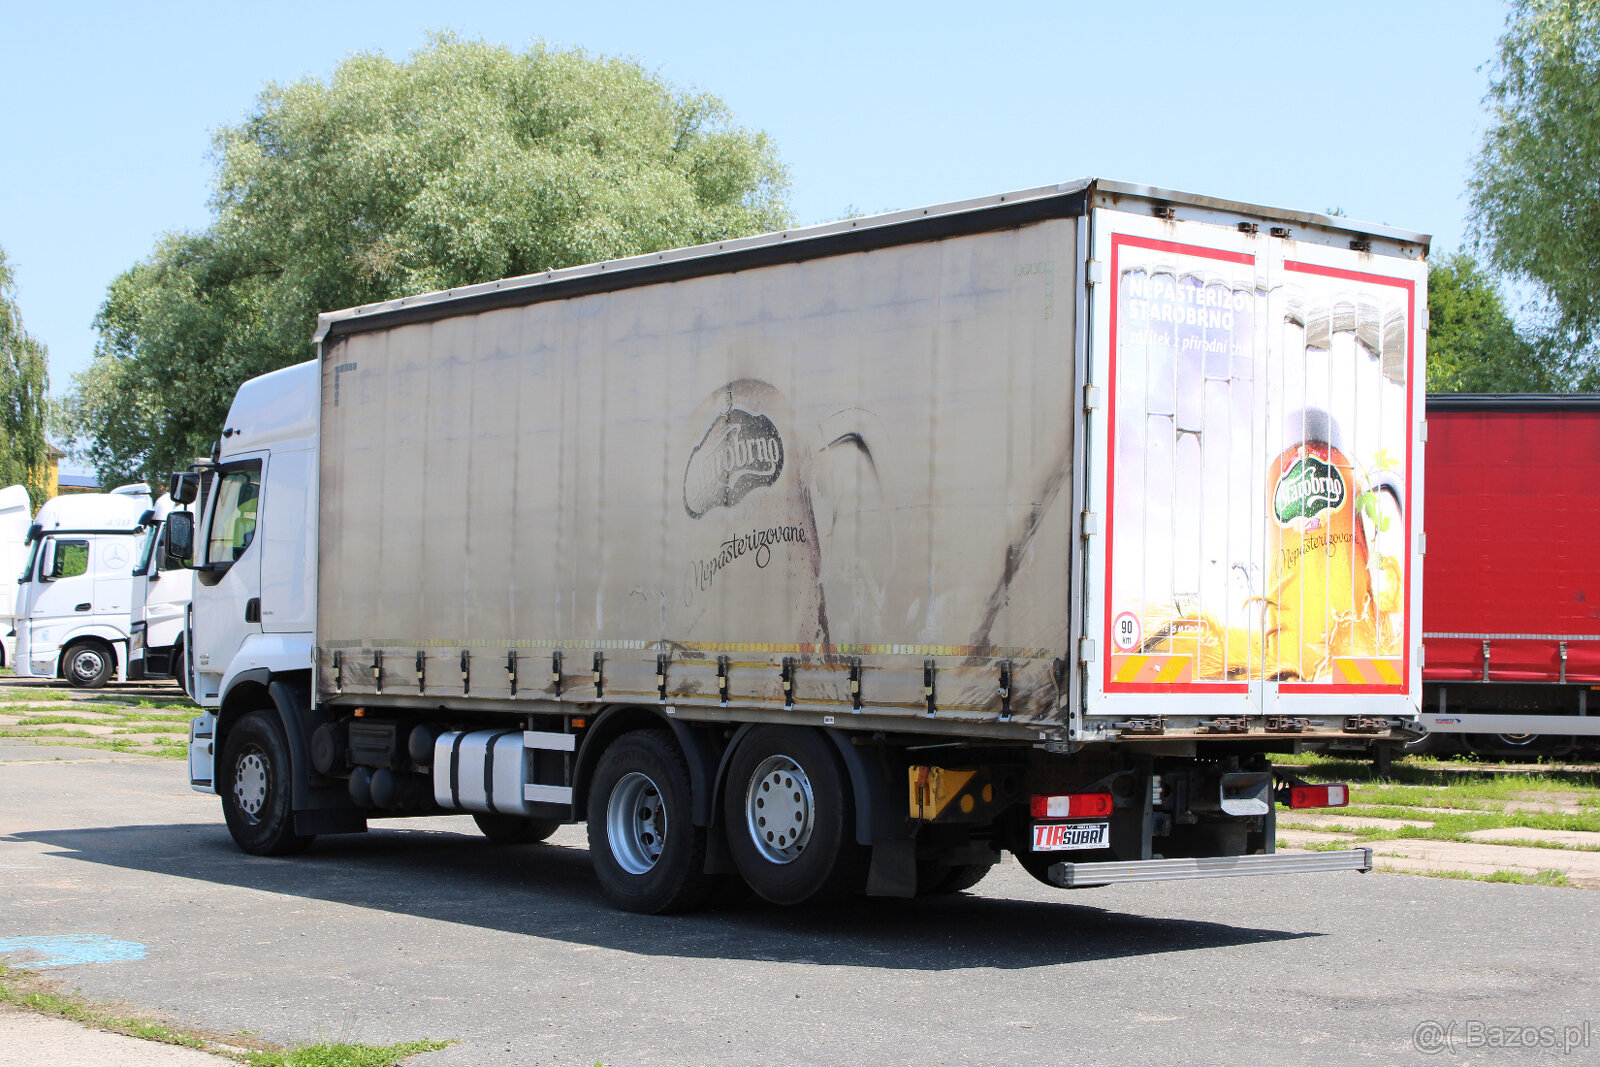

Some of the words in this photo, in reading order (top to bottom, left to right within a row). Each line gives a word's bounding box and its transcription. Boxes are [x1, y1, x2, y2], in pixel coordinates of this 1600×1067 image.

[1129, 299, 1234, 332] STAROBRNO
[684, 522, 806, 607] Nepasterizované
[1121, 620, 1133, 634] 90
[1122, 636, 1132, 645] km
